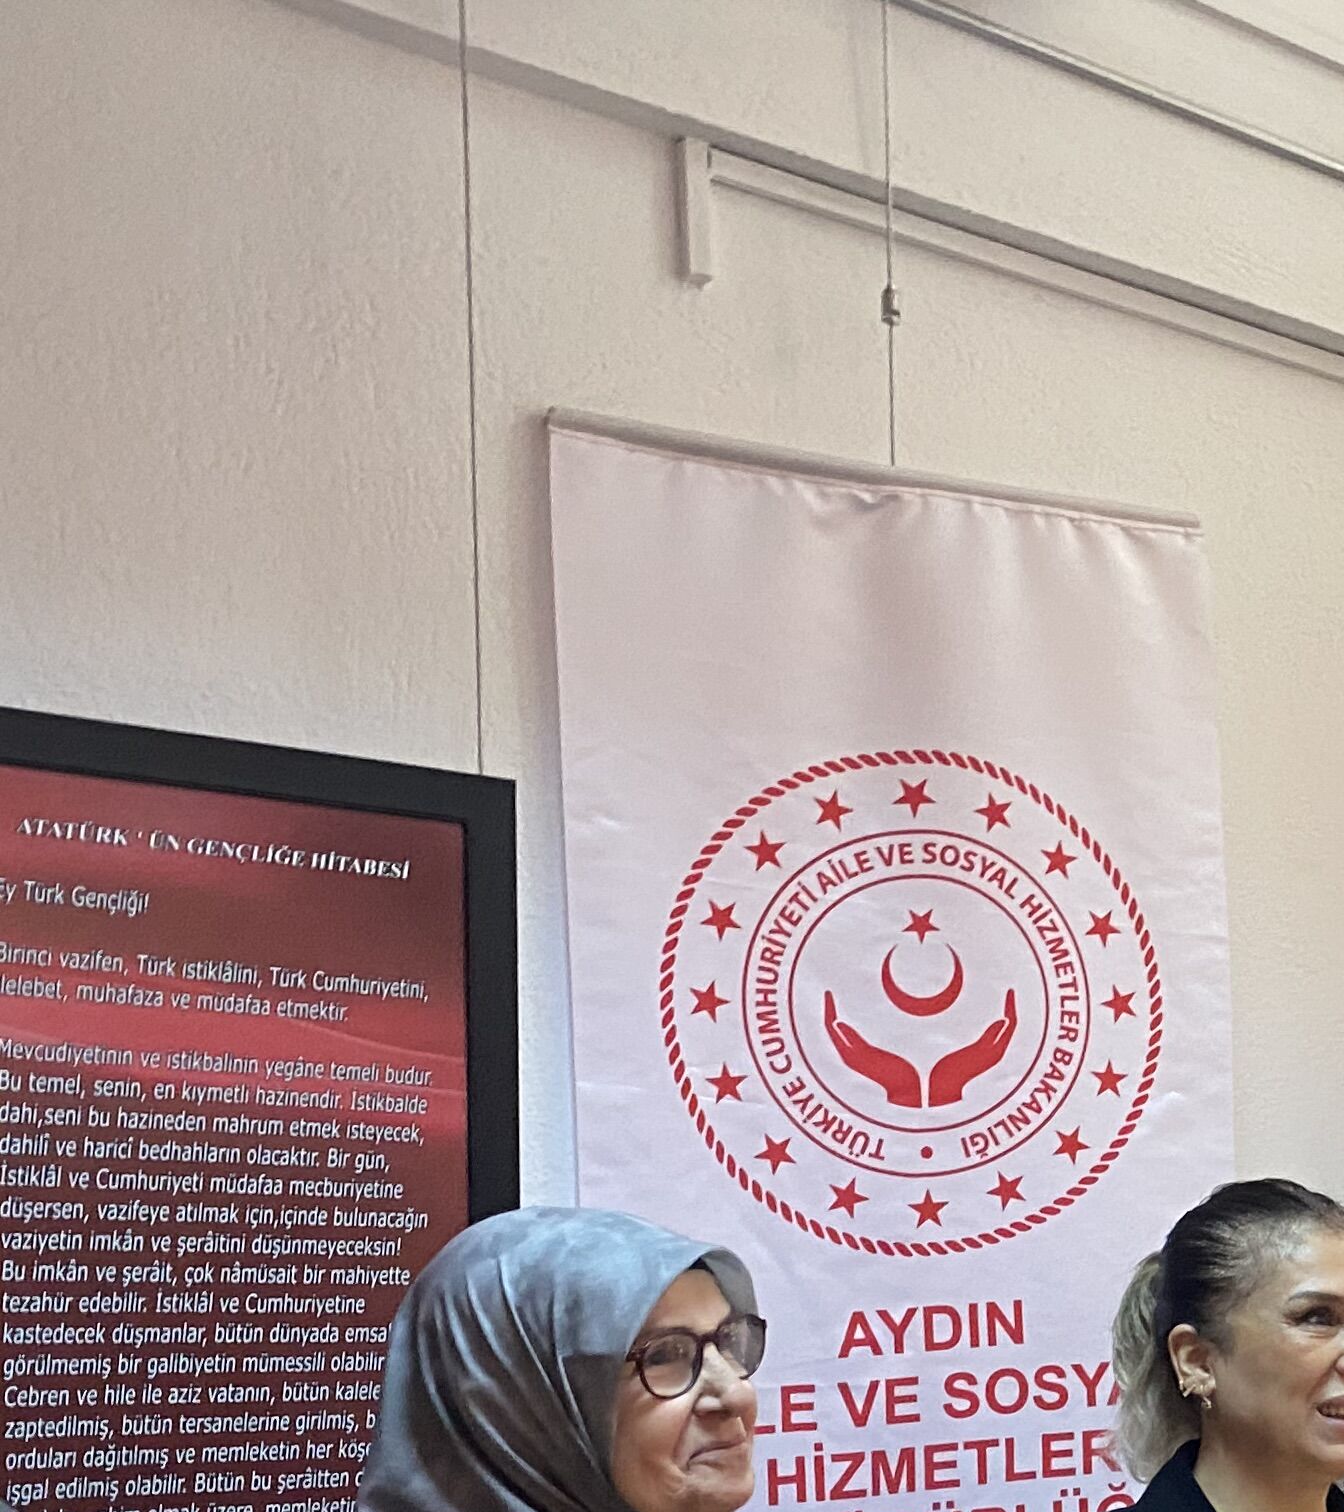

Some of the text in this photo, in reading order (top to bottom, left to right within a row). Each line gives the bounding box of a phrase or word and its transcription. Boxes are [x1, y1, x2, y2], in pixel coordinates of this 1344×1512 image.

[16, 819, 410, 881] ATATÜRK ÜN GENÇLİĞE HİTABESİ
[24, 880, 150, 918] Türk Gençliği!
[59, 950, 129, 976] vazifen,
[136, 954, 177, 976] Türk
[182, 960, 263, 988] istiklâlini,
[269, 967, 308, 989] Türk
[312, 971, 429, 1002] Cumhuriyetini,
[76, 983, 349, 1021] muhafaza müdafaa etmektir.
[754, 841, 1080, 1161] TÜRKİYE CUMHURİYETİ AİLE VE SOSYAL HİZMETLER BAKANLIĞI
[0, 1038, 433, 1087] Mevcudiyetinin istikbalinin yegâne temeli budur.
[0, 1069, 428, 1114] Bu temel, senin, en kıymetli hazinendir. İstikbalde
[0, 1101, 425, 1146] dahi,seni bu hazineden mahrum etmek isteyecek,
[0, 1132, 391, 1174] dahilî haricî bedhahların olacaktır. Bir gün,
[0, 1160, 404, 1203] İstiklâl Cumhuriyeti müdafaa mecburiyetine
[0, 1196, 429, 1233] düşersen, vazifeye atılmak için,içinde bulunacağın
[0, 1228, 402, 1259] vaziyetin imkân şerâitini düşünmeyeceksin!
[0, 1259, 411, 1291] Bu imkân şerâit, çok nâmüsait bir mahiyette
[2, 1288, 366, 1318] tezahür edebilir. İstiklâl Cumhuriyetine
[2, 1317, 340, 1348] kastedecek düşmanlar, bütün dünyada
[838, 1299, 1024, 1358] AYDIN
[3, 1346, 326, 1381] görülmemiş bir galibiyetin mümessili
[4, 1381, 330, 1408] Cebren hile ile aziz vatanın, bütün
[837, 1375, 921, 1427] VE
[4, 1415, 114, 1442] zaptedilmiş,
[121, 1414, 173, 1435] bütün
[179, 1412, 291, 1434] tersanelerine
[295, 1410, 360, 1435] girilmiş,
[5, 1439, 335, 1471] orduları dağıtılmış memleketin her
[6, 1478, 49, 1509] işgal
[54, 1476, 120, 1502] edilmiş
[124, 1473, 187, 1496] olabilir.
[194, 1472, 245, 1493] Bütün
[250, 1470, 272, 1491] bu
[277, 1467, 350, 1494] şerâitten
